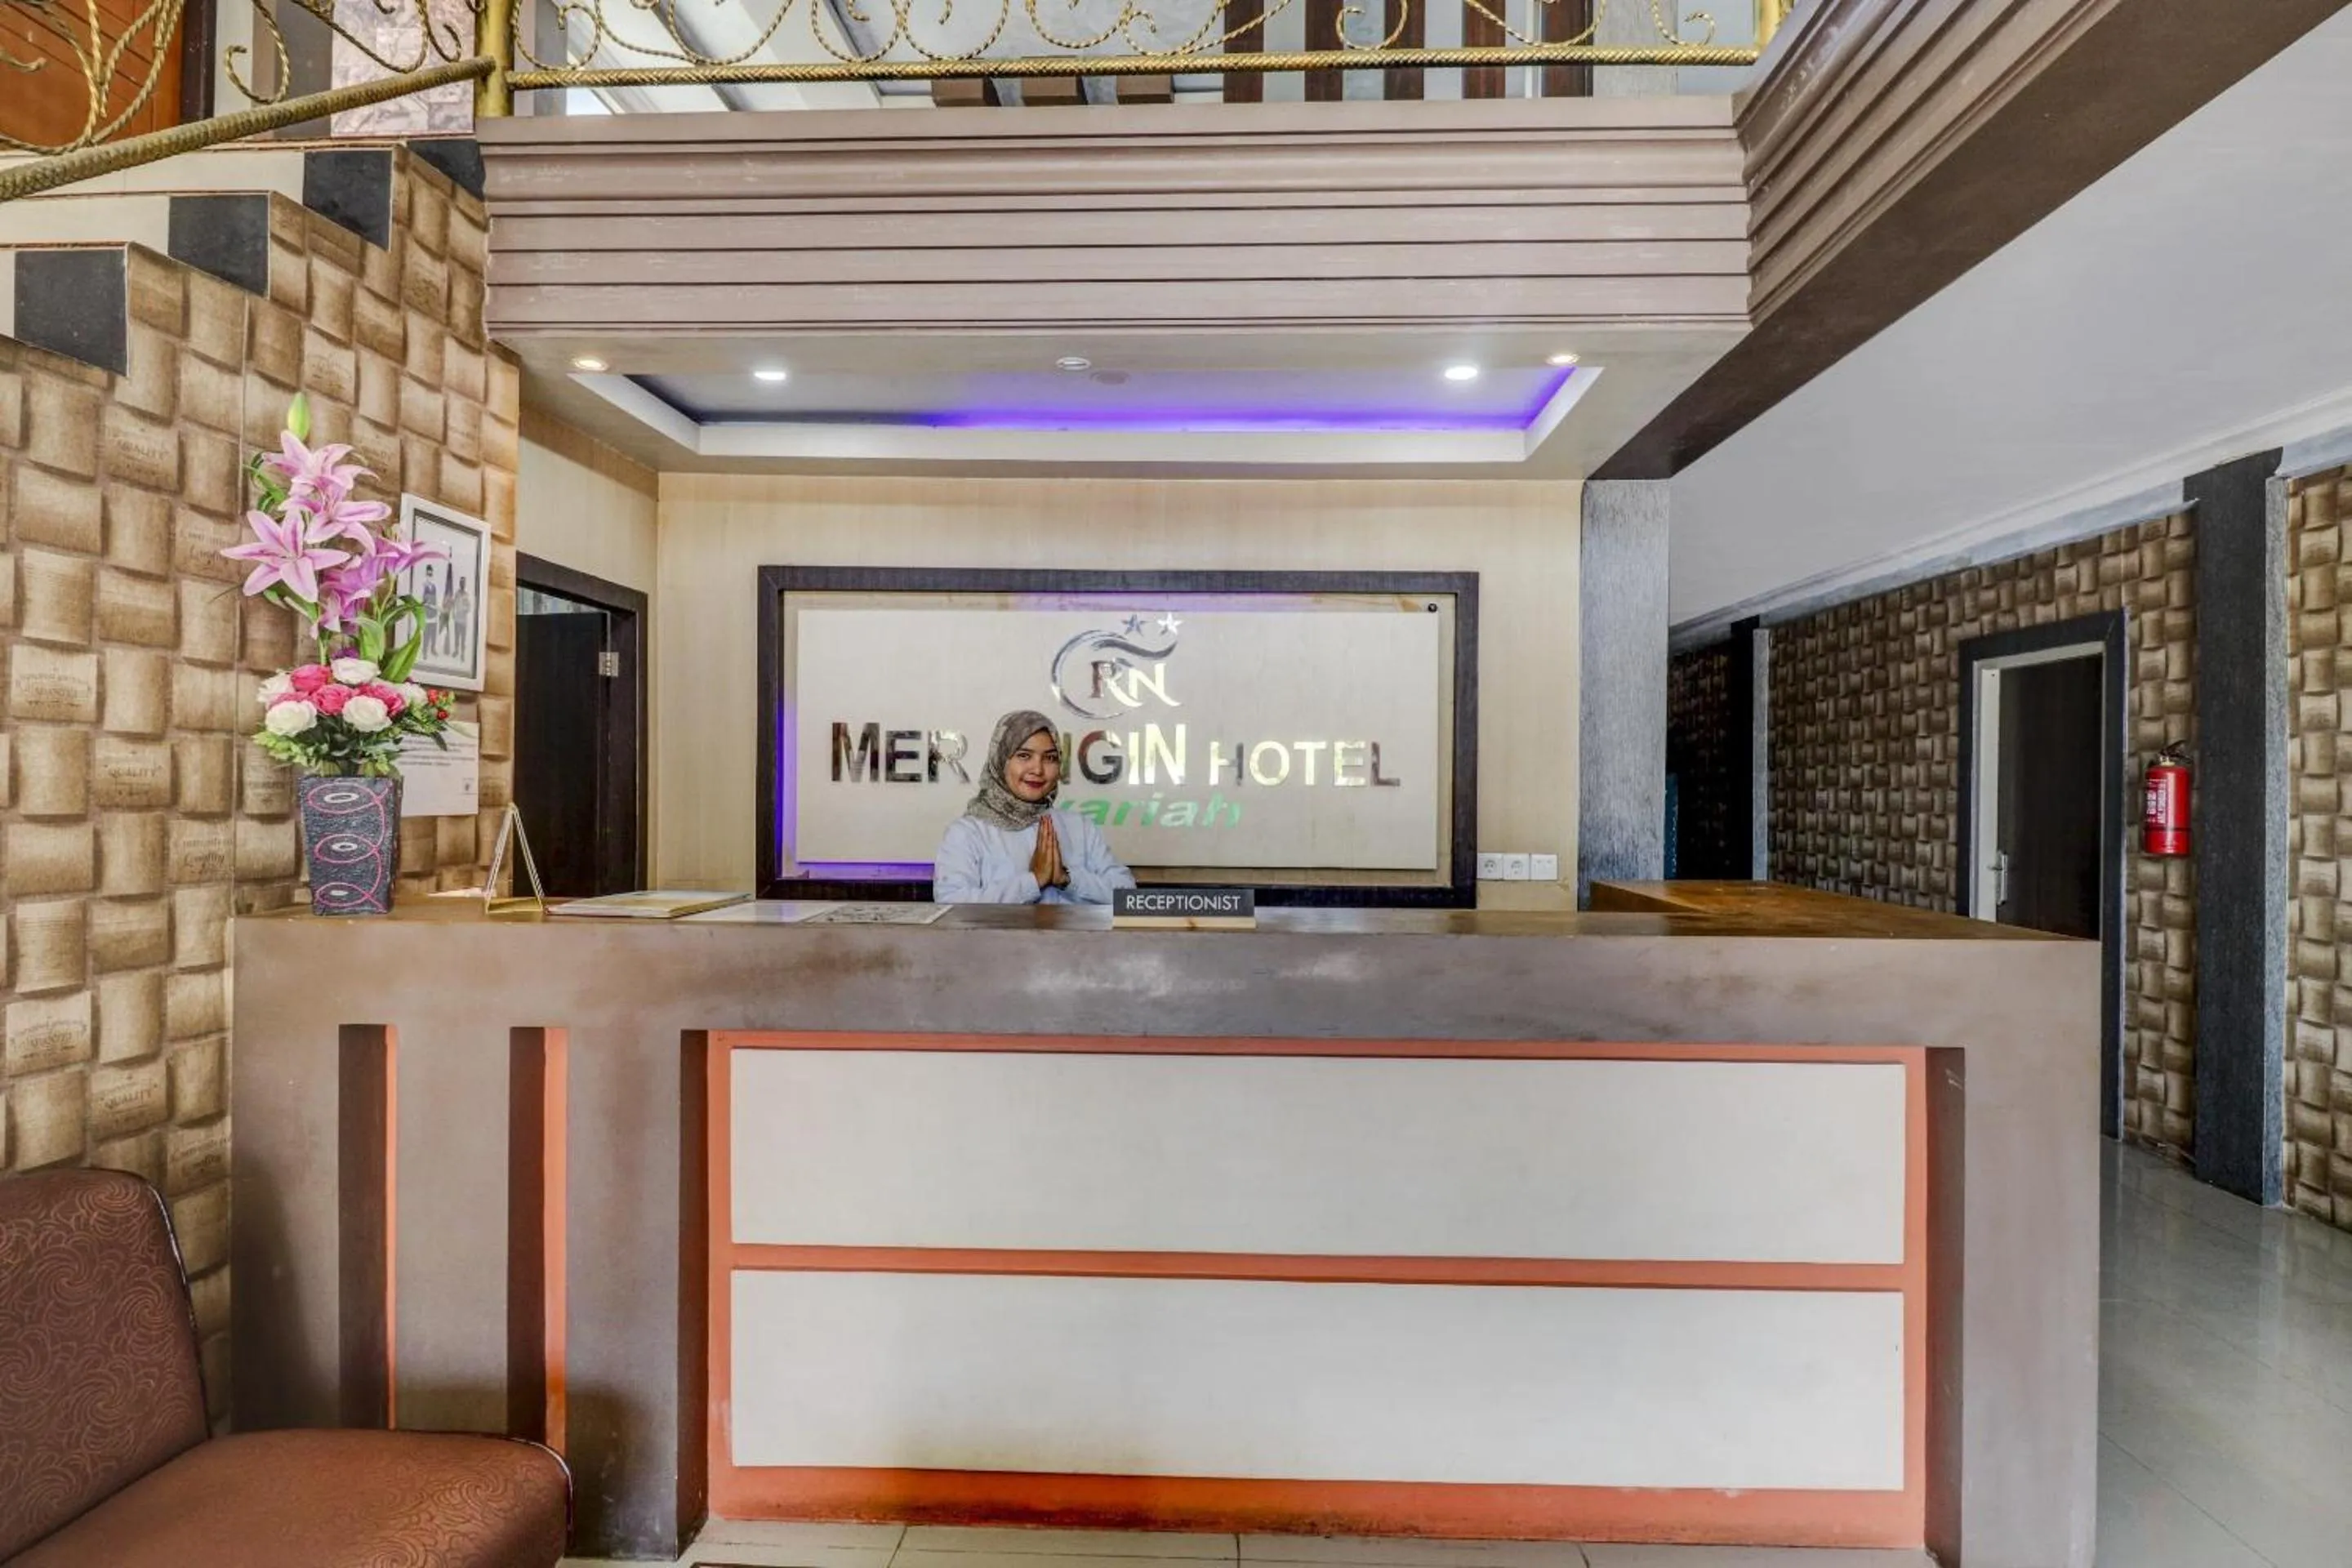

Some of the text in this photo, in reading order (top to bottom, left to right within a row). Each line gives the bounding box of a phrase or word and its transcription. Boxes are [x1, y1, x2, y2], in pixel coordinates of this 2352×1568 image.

[831, 722, 1401, 786] MERGIN HOTEL
[1059, 792, 1244, 828] ariah
[1126, 894, 1241, 911] RECEPTIONIST
